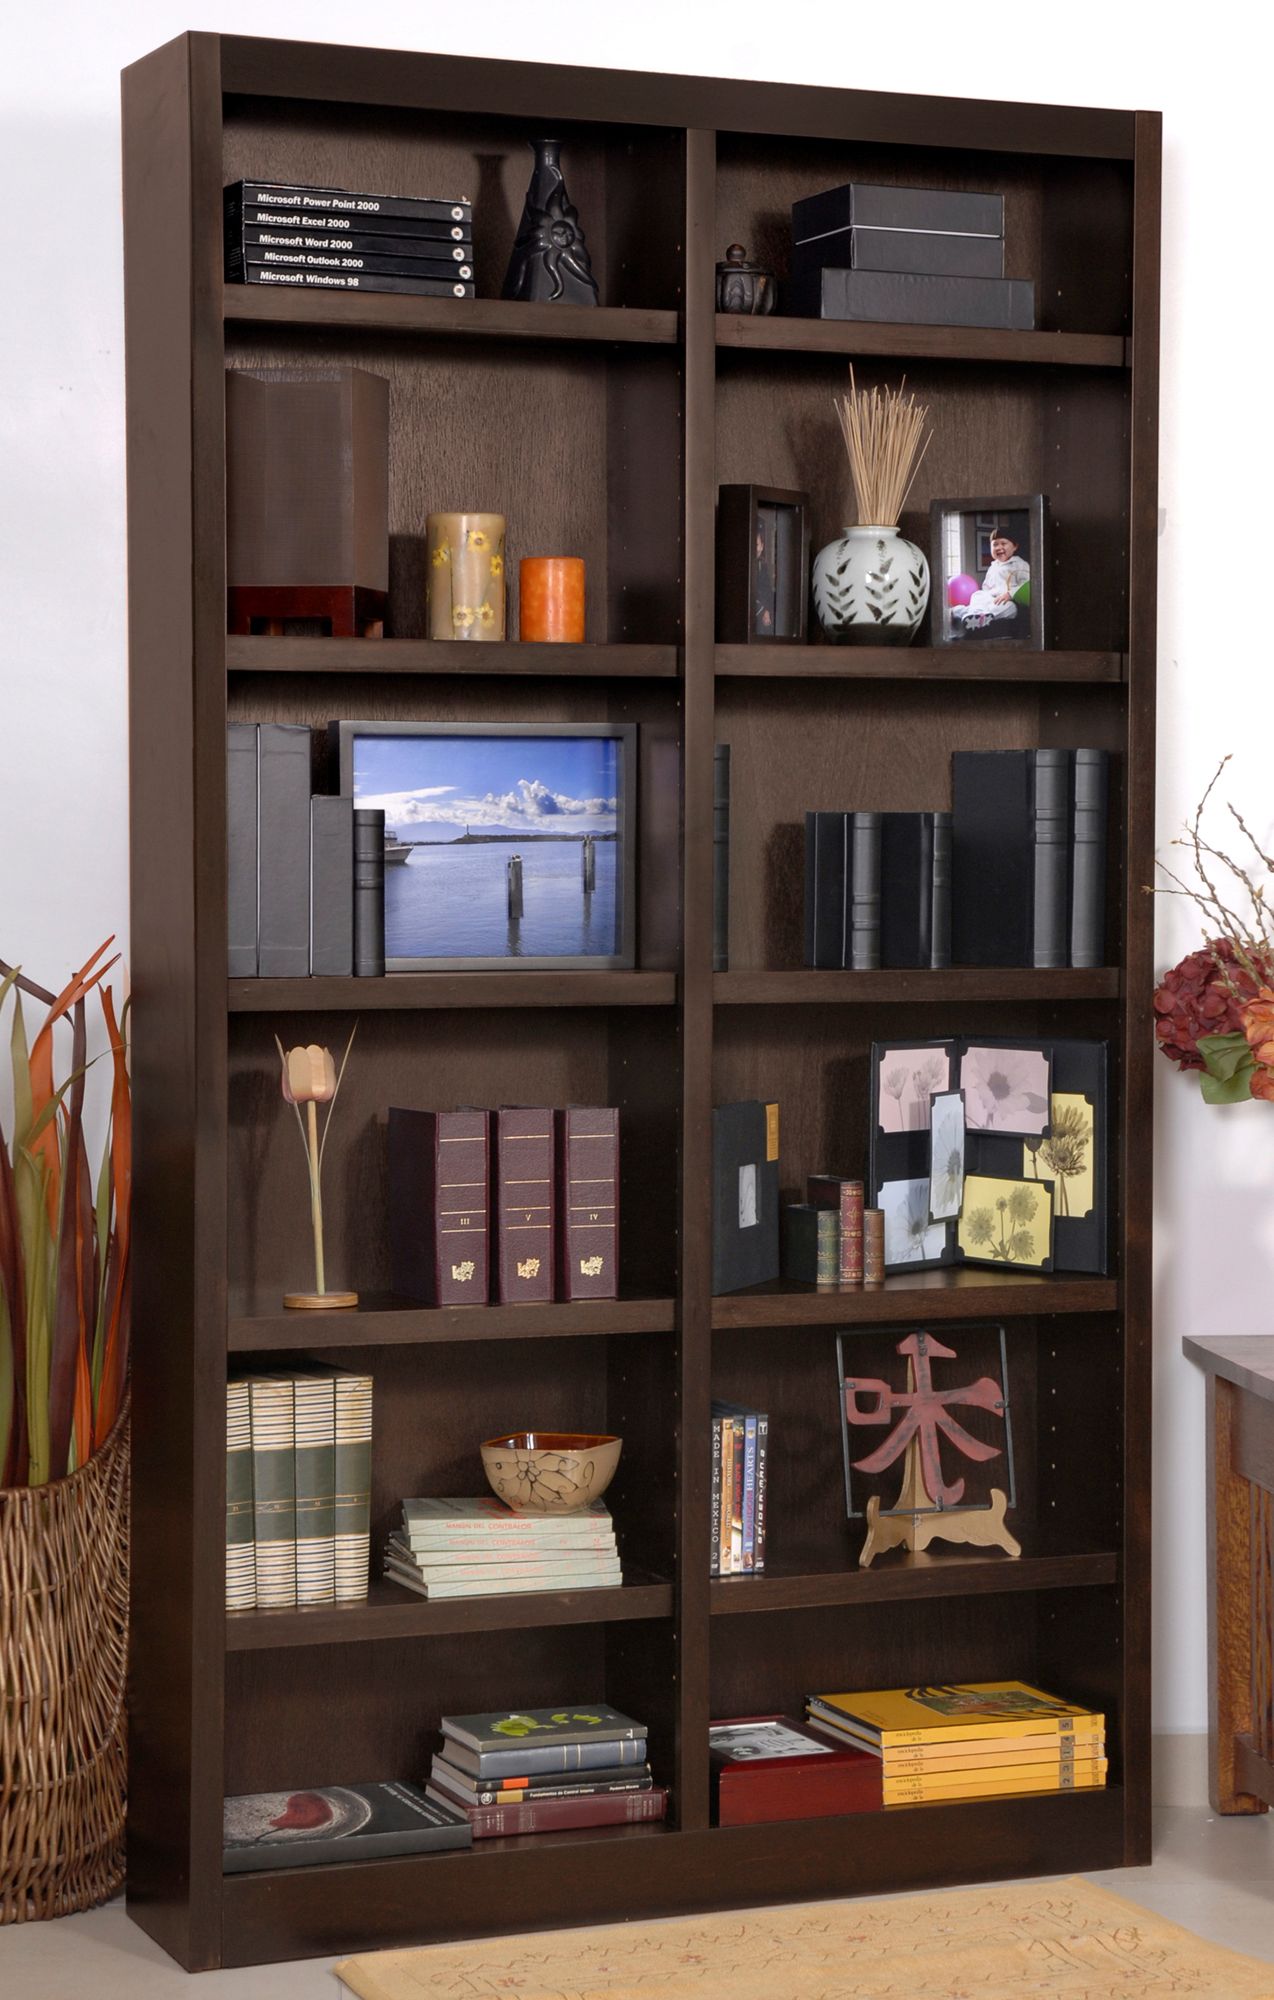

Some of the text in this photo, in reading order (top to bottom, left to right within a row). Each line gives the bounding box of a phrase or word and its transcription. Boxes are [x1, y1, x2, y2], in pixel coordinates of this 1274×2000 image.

[257, 193, 380, 211] Microsoft Power Point 2000
[257, 212, 350, 229] Microsoft Excel 2000
[259, 234, 353, 249] Microsoft Word 2000
[264, 251, 363, 267] Microsoft Outlook 2000
[260, 271, 359, 287] Microsoft Windows 98
[460, 1217, 470, 1225] III
[712, 1425, 721, 1458] MADE
[712, 1468, 720, 1483] IN
[746, 1446, 754, 1491] HEARTS
[711, 1493, 720, 1543] MEXICO
[711, 1552, 718, 1560] 2
